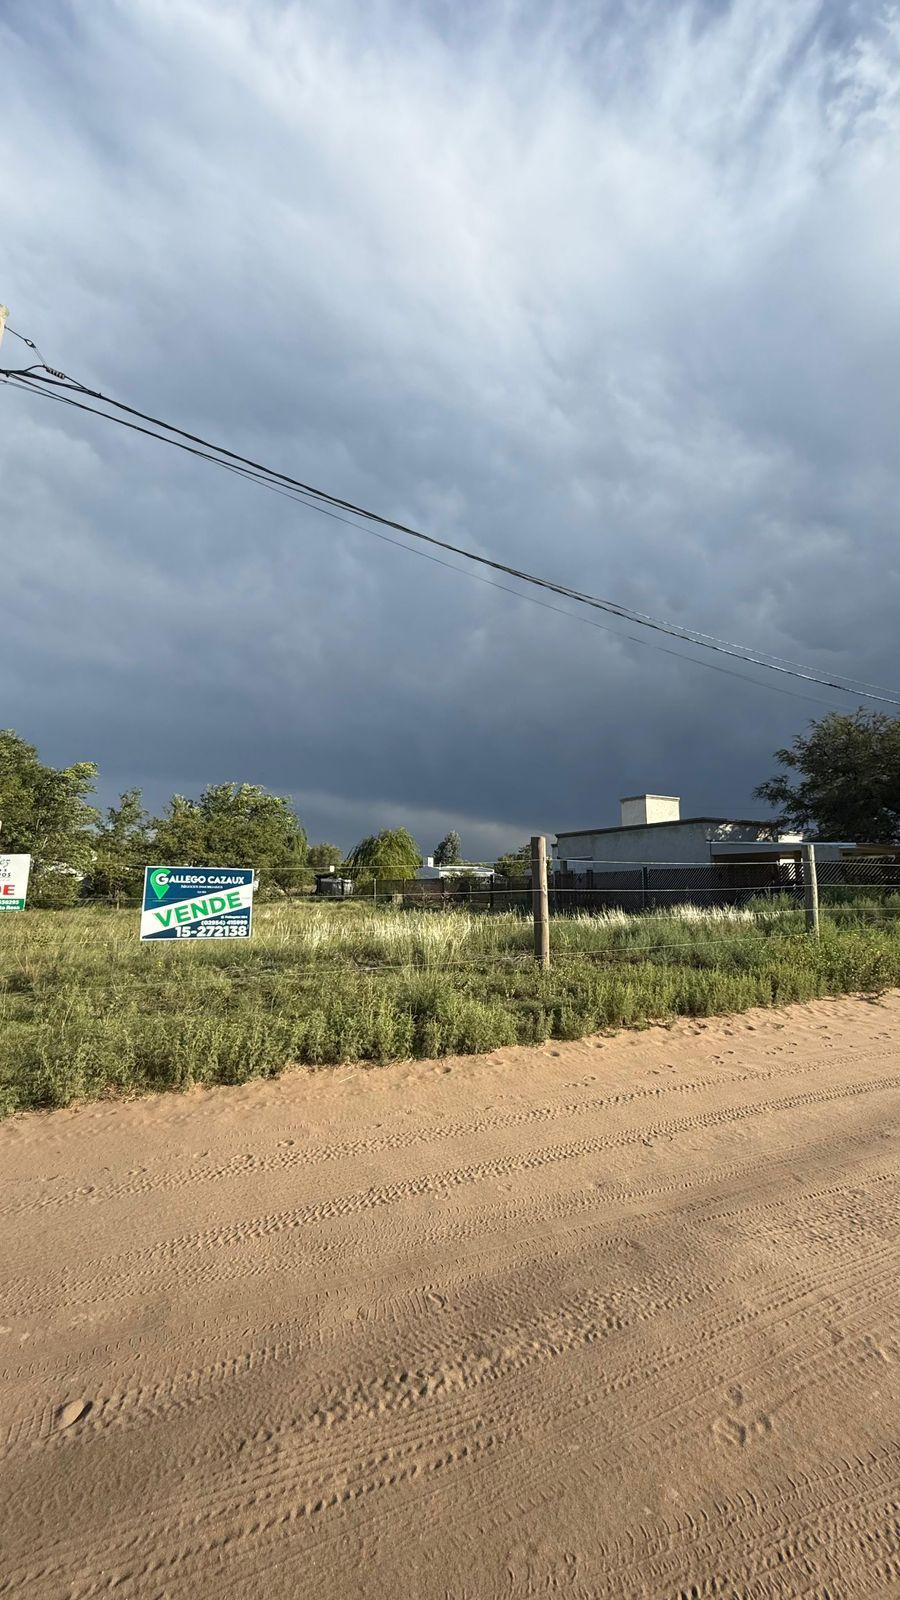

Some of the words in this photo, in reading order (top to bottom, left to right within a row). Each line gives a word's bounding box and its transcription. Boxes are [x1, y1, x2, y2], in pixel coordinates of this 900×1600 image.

[155, 873, 206, 886] GALLEGO
[207, 875, 245, 885] CAZAUX
[0, 884, 15, 896] E
[154, 891, 242, 928] VENDE
[175, 926, 247, 937] 15-272138
